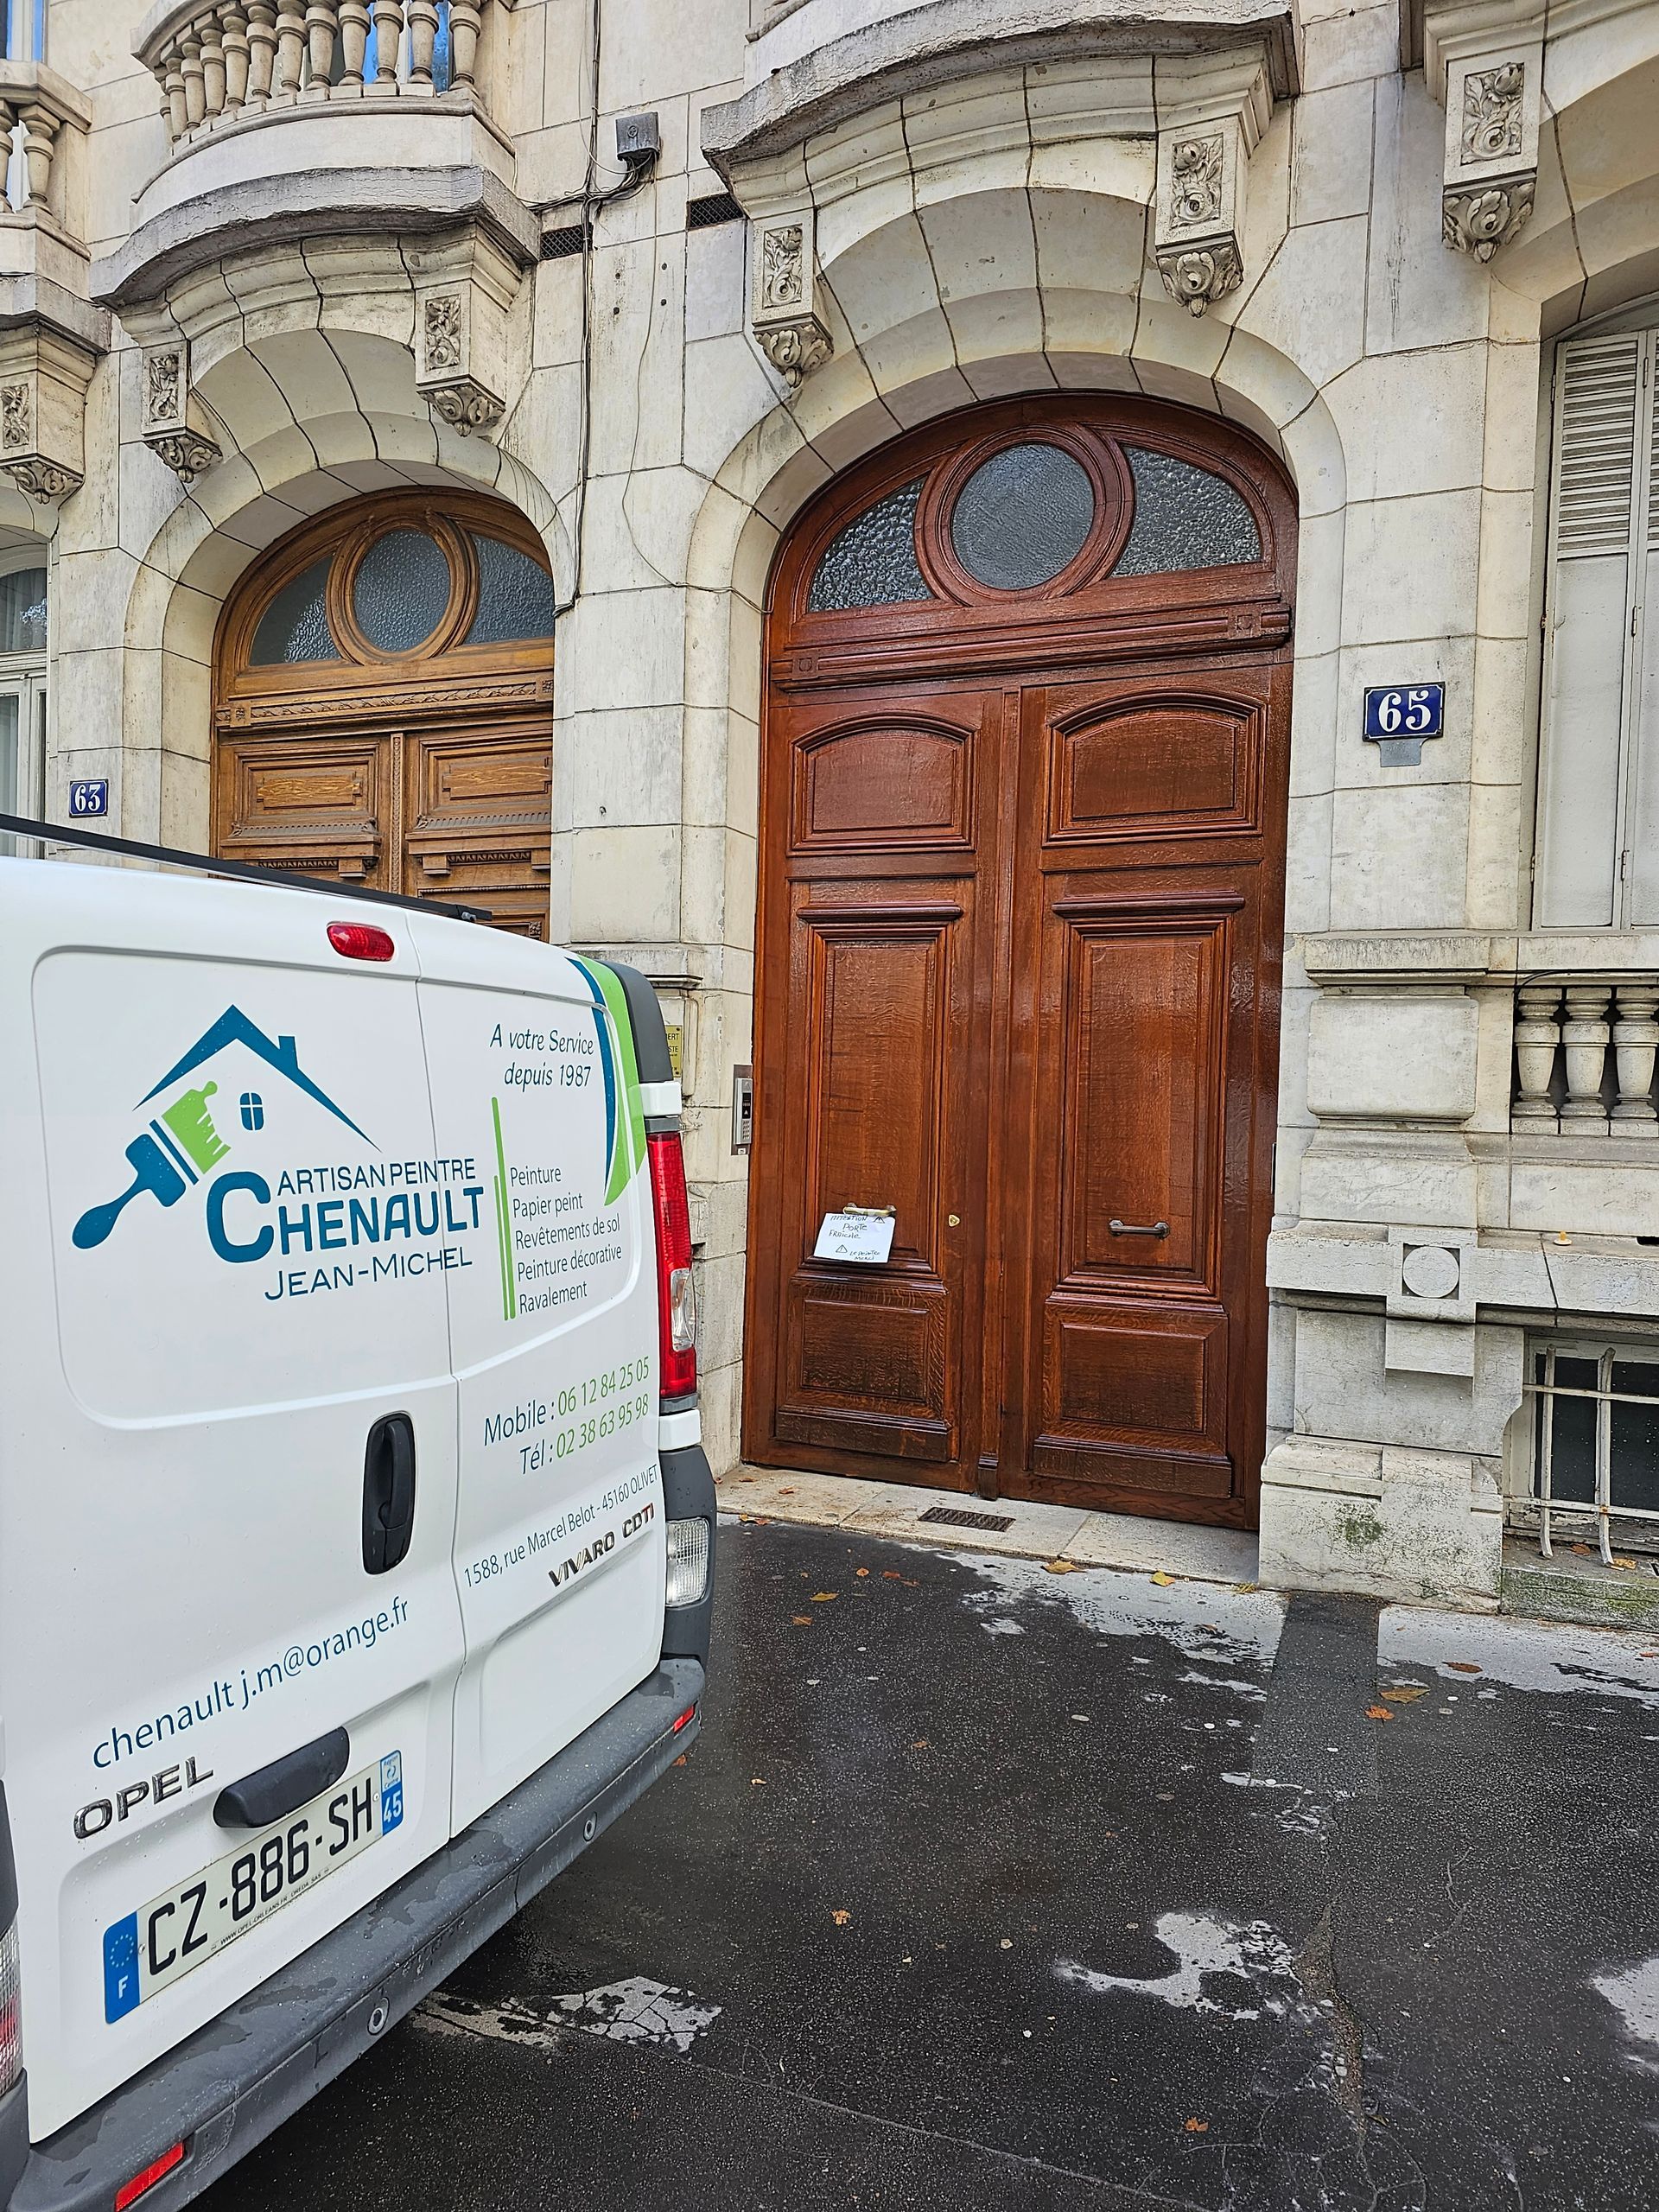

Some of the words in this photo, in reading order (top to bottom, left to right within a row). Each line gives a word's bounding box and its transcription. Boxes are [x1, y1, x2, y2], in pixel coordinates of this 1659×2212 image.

[1378, 690, 1431, 732] 65
[74, 785, 101, 811] 63
[490, 1023, 502, 1047] A
[509, 1029, 544, 1051] votre
[550, 1030, 594, 1055] Service
[504, 1062, 553, 1092] depuis
[560, 1065, 591, 1087] 1987
[277, 1164, 385, 1196] ARTISAN
[391, 1158, 476, 1185] PEINTRE
[510, 1166, 562, 1187] Peinture
[206, 1171, 484, 1263] CHENAULT
[513, 1196, 551, 1221] Papier
[555, 1192, 583, 1217] peint
[515, 1222, 590, 1250] Revêtements
[593, 1217, 605, 1236] de
[607, 1213, 620, 1233] sol
[518, 1259, 568, 1282] Peinture
[570, 1243, 622, 1270] décorative
[519, 1281, 588, 1314] Ravalement
[558, 1386, 576, 1416] 06
[582, 1379, 596, 1406] 12
[601, 1370, 616, 1398] 84
[620, 1363, 633, 1390] 25
[636, 1356, 649, 1382] 05
[556, 1428, 575, 1459] 02
[579, 1419, 595, 1448] 38
[600, 1410, 614, 1438] 63
[619, 1402, 632, 1429] 95
[636, 1394, 649, 1421] 98
[464, 1555, 503, 1587] 1588,
[504, 1545, 525, 1567] rue
[527, 1516, 567, 1555] Marcel
[568, 1504, 595, 1532] Belot
[602, 1483, 629, 1511] 45160
[630, 1464, 658, 1494] OLIVET
[548, 1531, 614, 1587] VIVARO
[621, 1503, 654, 1538] CDTI
[93, 1681, 235, 1768] chenault
[241, 1596, 409, 1710] j.m@orange.fr
[73, 1756, 214, 1840] OPEL
[383, 1790, 401, 1823] 45
[148, 1777, 372, 1976] CZ-886-SH
[118, 1975, 130, 1999] F
